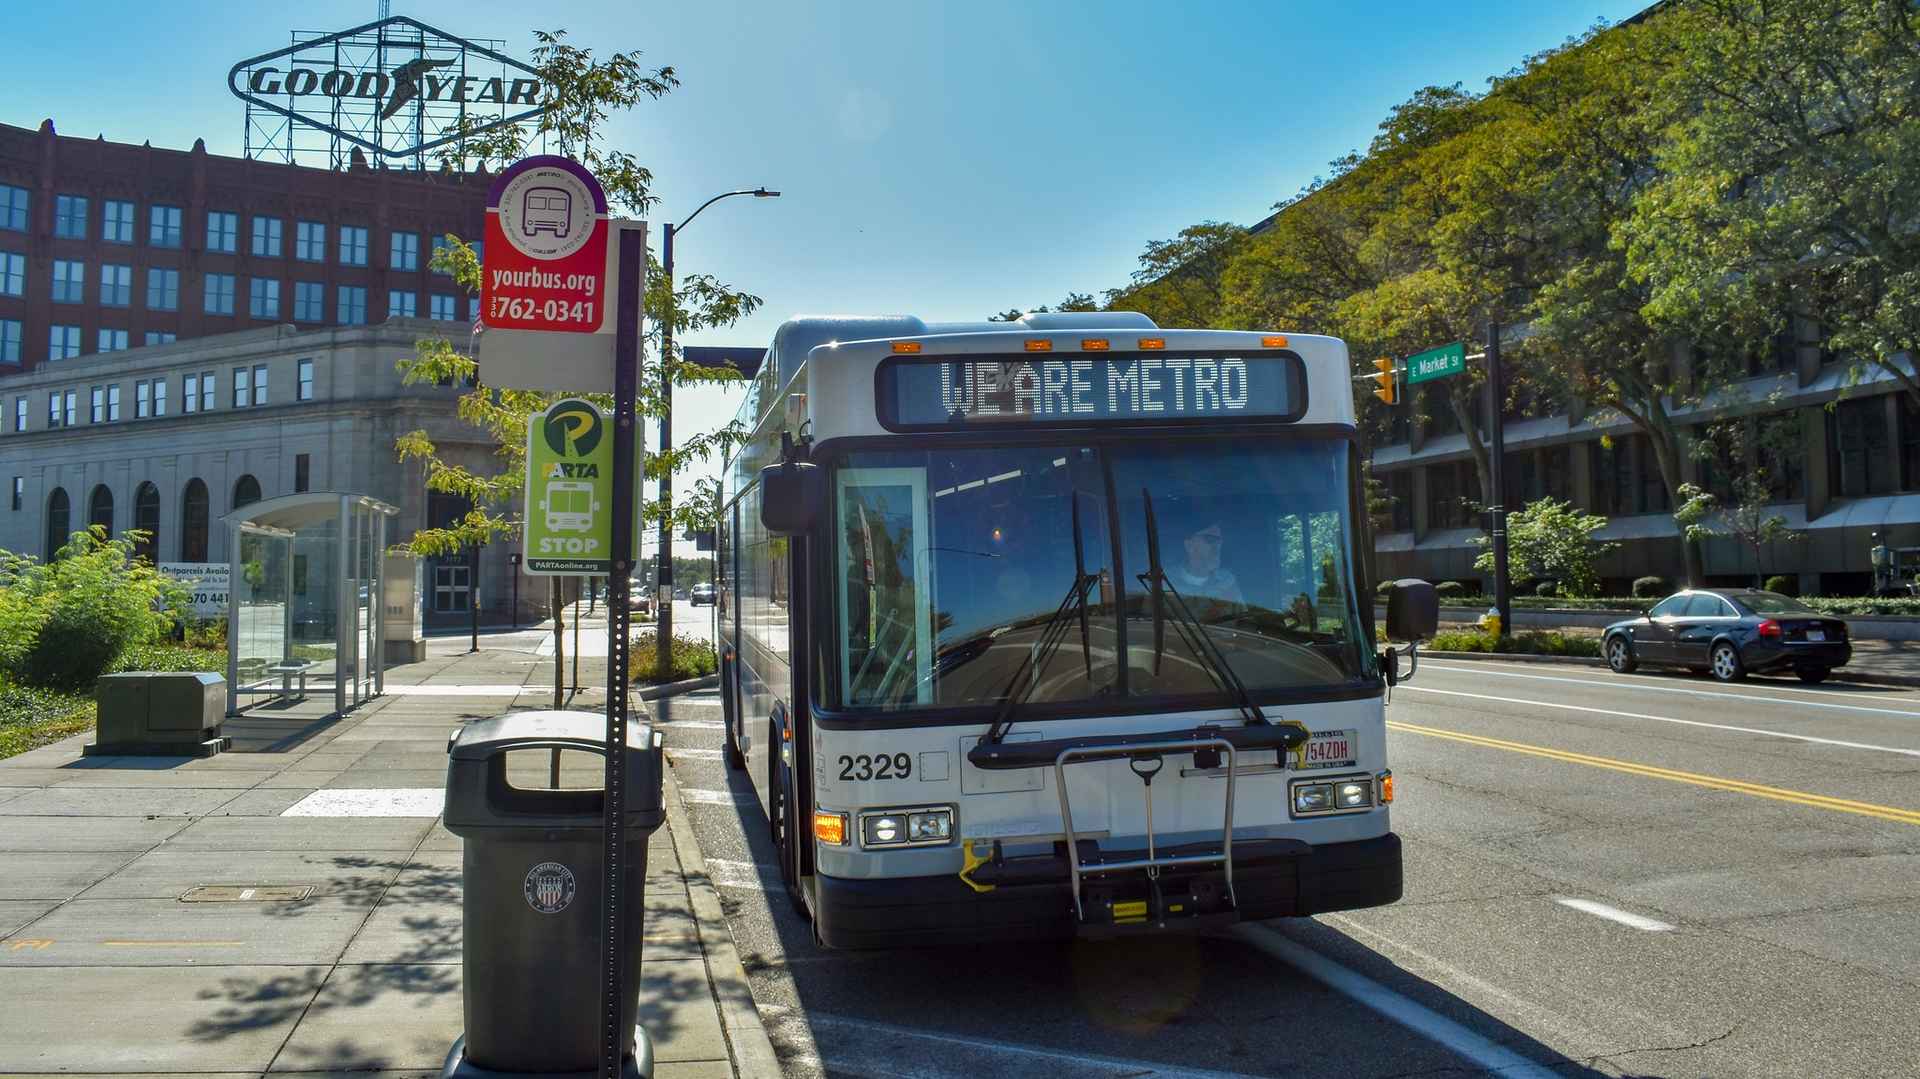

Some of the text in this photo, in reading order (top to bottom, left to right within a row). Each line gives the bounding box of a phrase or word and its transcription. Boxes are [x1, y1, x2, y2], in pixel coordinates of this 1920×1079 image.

[566, 179, 590, 211] yourbus.org
[504, 215, 528, 248] yourbus.org
[492, 266, 596, 297] yourbus.org
[498, 296, 595, 323] 762-0341
[1412, 353, 1459, 378] E Market St
[941, 357, 1248, 416] WE ARE METRO
[541, 462, 600, 479] PARTA
[539, 537, 599, 554] STOP
[161, 566, 229, 576] Outparcels Availa
[535, 561, 599, 572] PARTAonline.org
[210, 593, 229, 604] 441
[838, 752, 912, 781] 2329
[537, 884, 562, 893] AKRON
